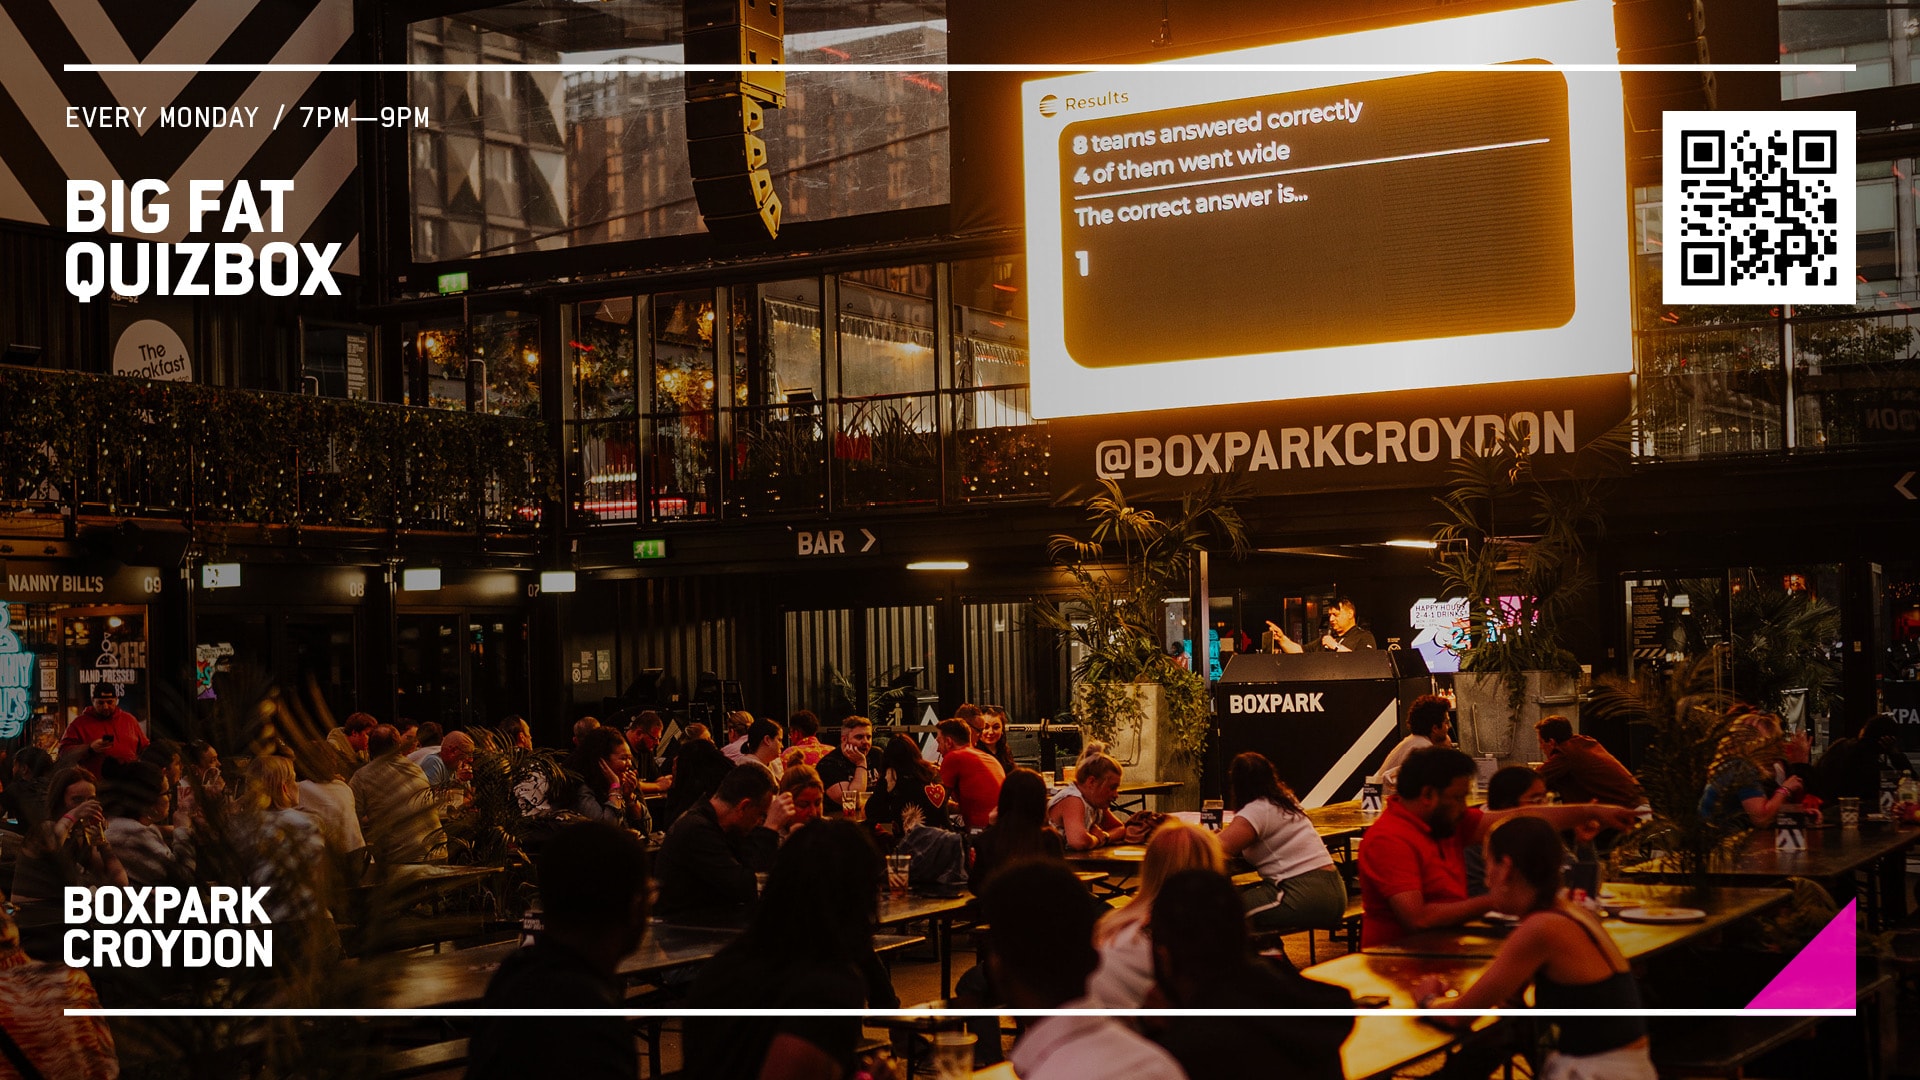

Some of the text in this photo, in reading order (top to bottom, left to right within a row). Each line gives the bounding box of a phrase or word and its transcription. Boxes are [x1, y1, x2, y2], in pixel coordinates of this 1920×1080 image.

[1065, 91, 1129, 111] Results
[1072, 99, 1364, 155] 8 teams answered correctly
[1073, 140, 1291, 185] 4 of them went wide
[1073, 182, 1309, 228] The correct answer is...
[1074, 250, 1089, 276] 1
[138, 344, 167, 361] The
[1095, 409, 1576, 480] @BOXPARKCROYDON
[797, 529, 846, 556] BAR
[8, 574, 104, 593] NANNY BILL'S
[143, 576, 162, 594] 09
[349, 582, 365, 598] 08
[527, 583, 540, 598] 07
[1415, 603, 1439, 612] HAPPY
[79, 668, 136, 684] HAND-PRESSED
[1229, 692, 1325, 714] BOXPARK
